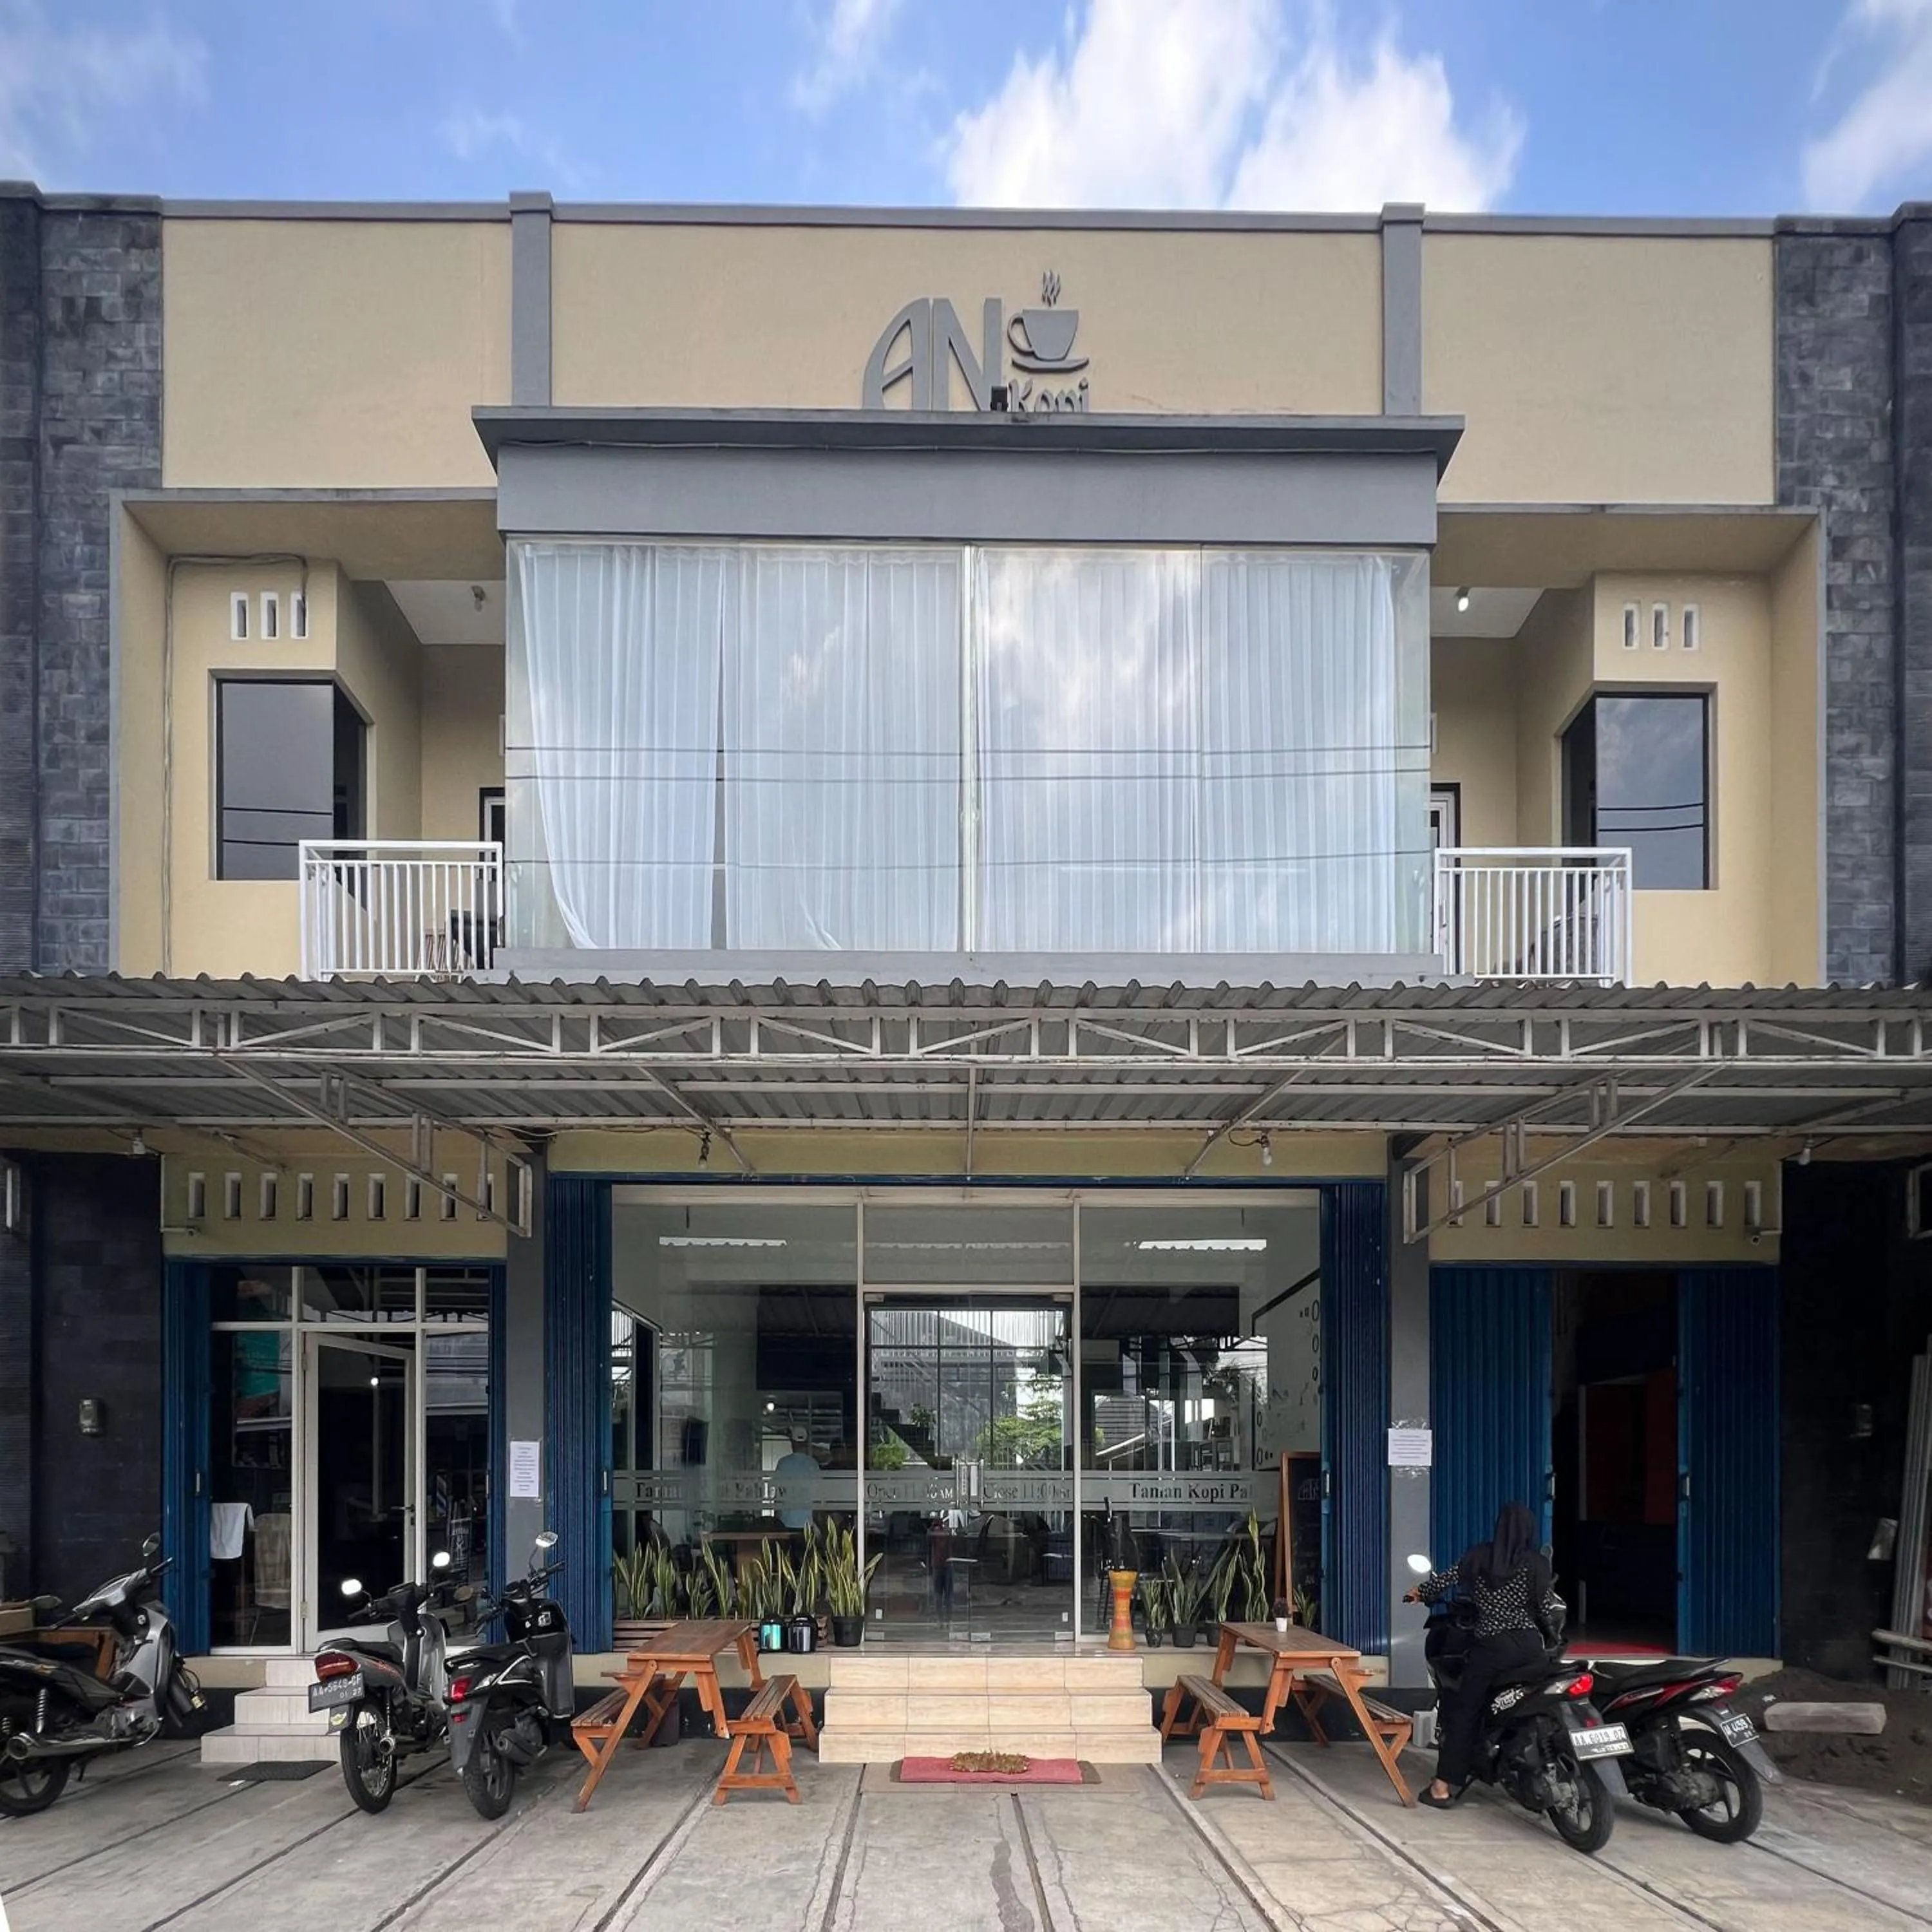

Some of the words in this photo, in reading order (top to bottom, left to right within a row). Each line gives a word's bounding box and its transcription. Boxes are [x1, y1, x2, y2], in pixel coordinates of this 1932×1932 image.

[862, 297, 1003, 412] AN
[1130, 1483, 1182, 1499] Taman
[1188, 1483, 1225, 1503] Kopi
